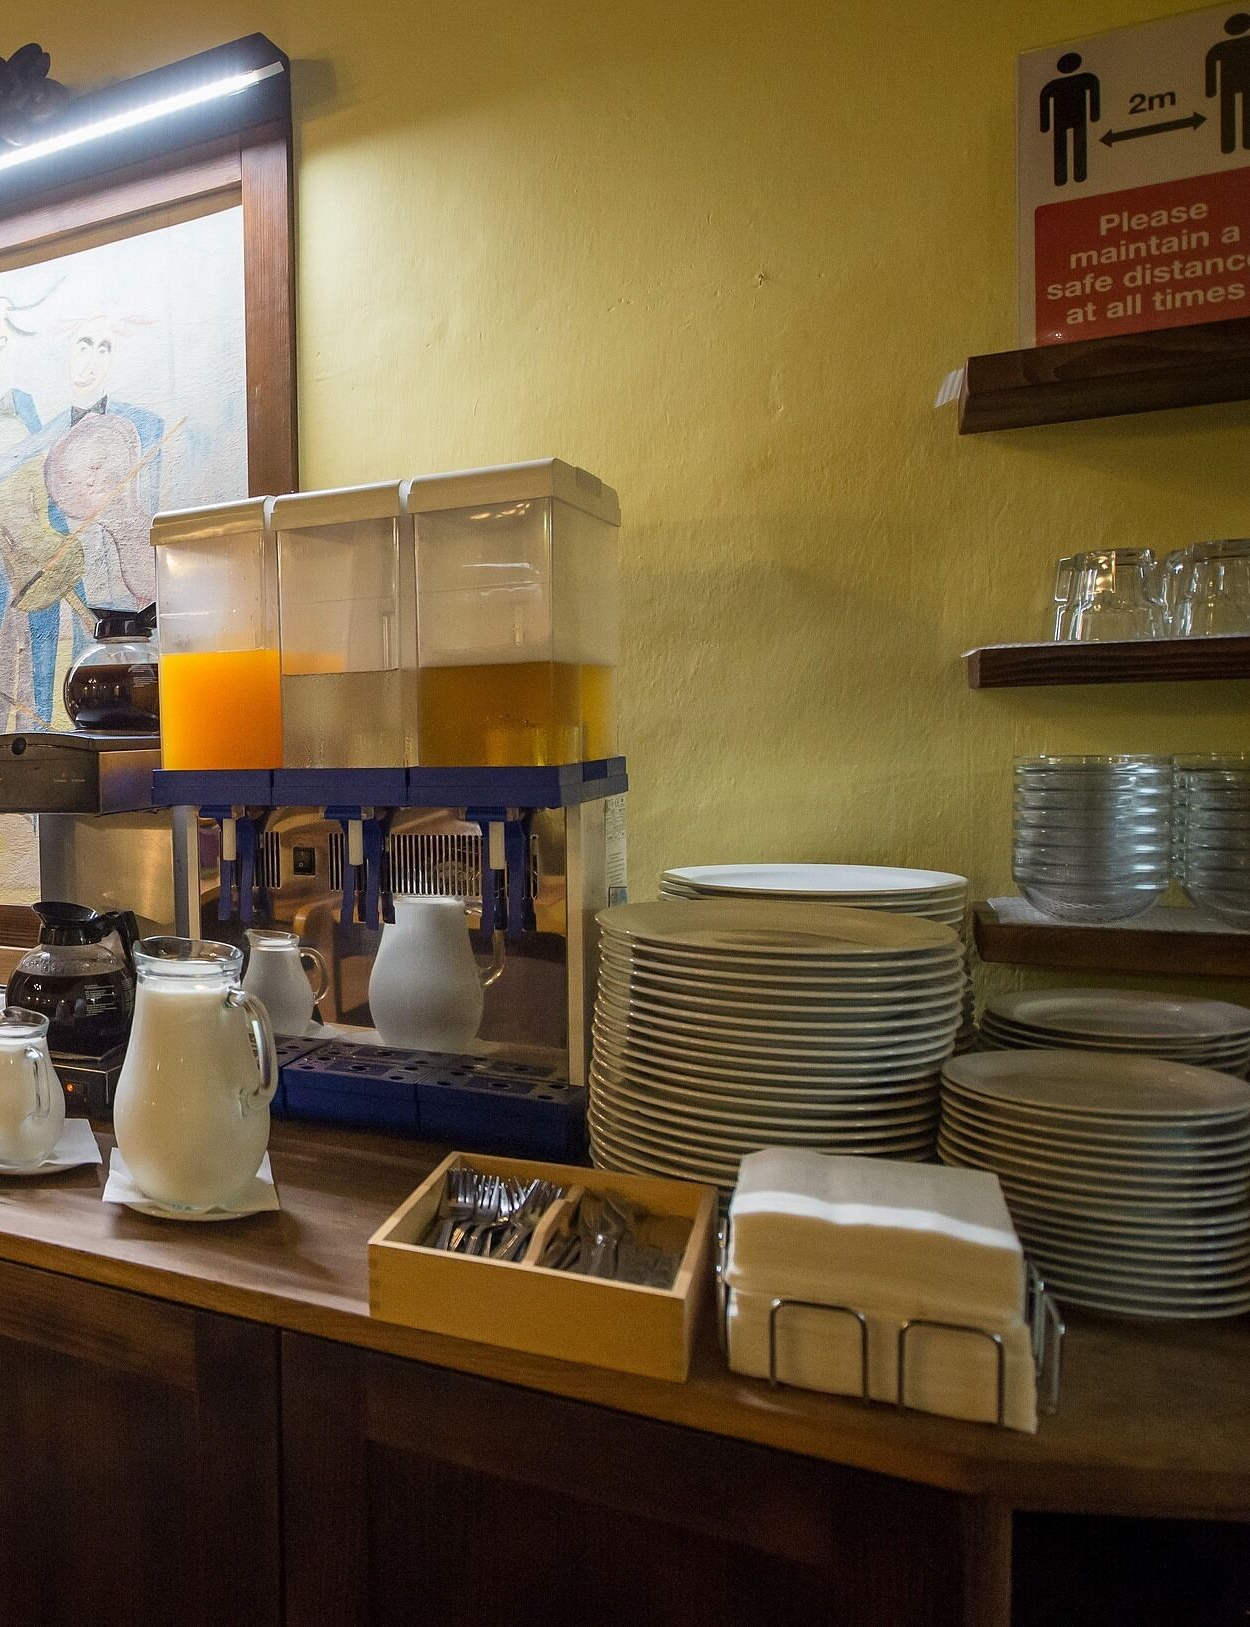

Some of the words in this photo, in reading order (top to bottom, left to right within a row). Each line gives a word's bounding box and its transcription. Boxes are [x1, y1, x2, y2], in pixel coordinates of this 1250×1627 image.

[1128, 90, 1176, 115] 2m
[1100, 202, 1209, 236] Please
[1070, 229, 1210, 269] maintain
[1221, 225, 1241, 244] a
[1046, 273, 1113, 300] safe
[1123, 251, 1250, 288] distanc
[1066, 302, 1096, 325] at
[1106, 293, 1142, 319] all
[1152, 282, 1246, 312] times
